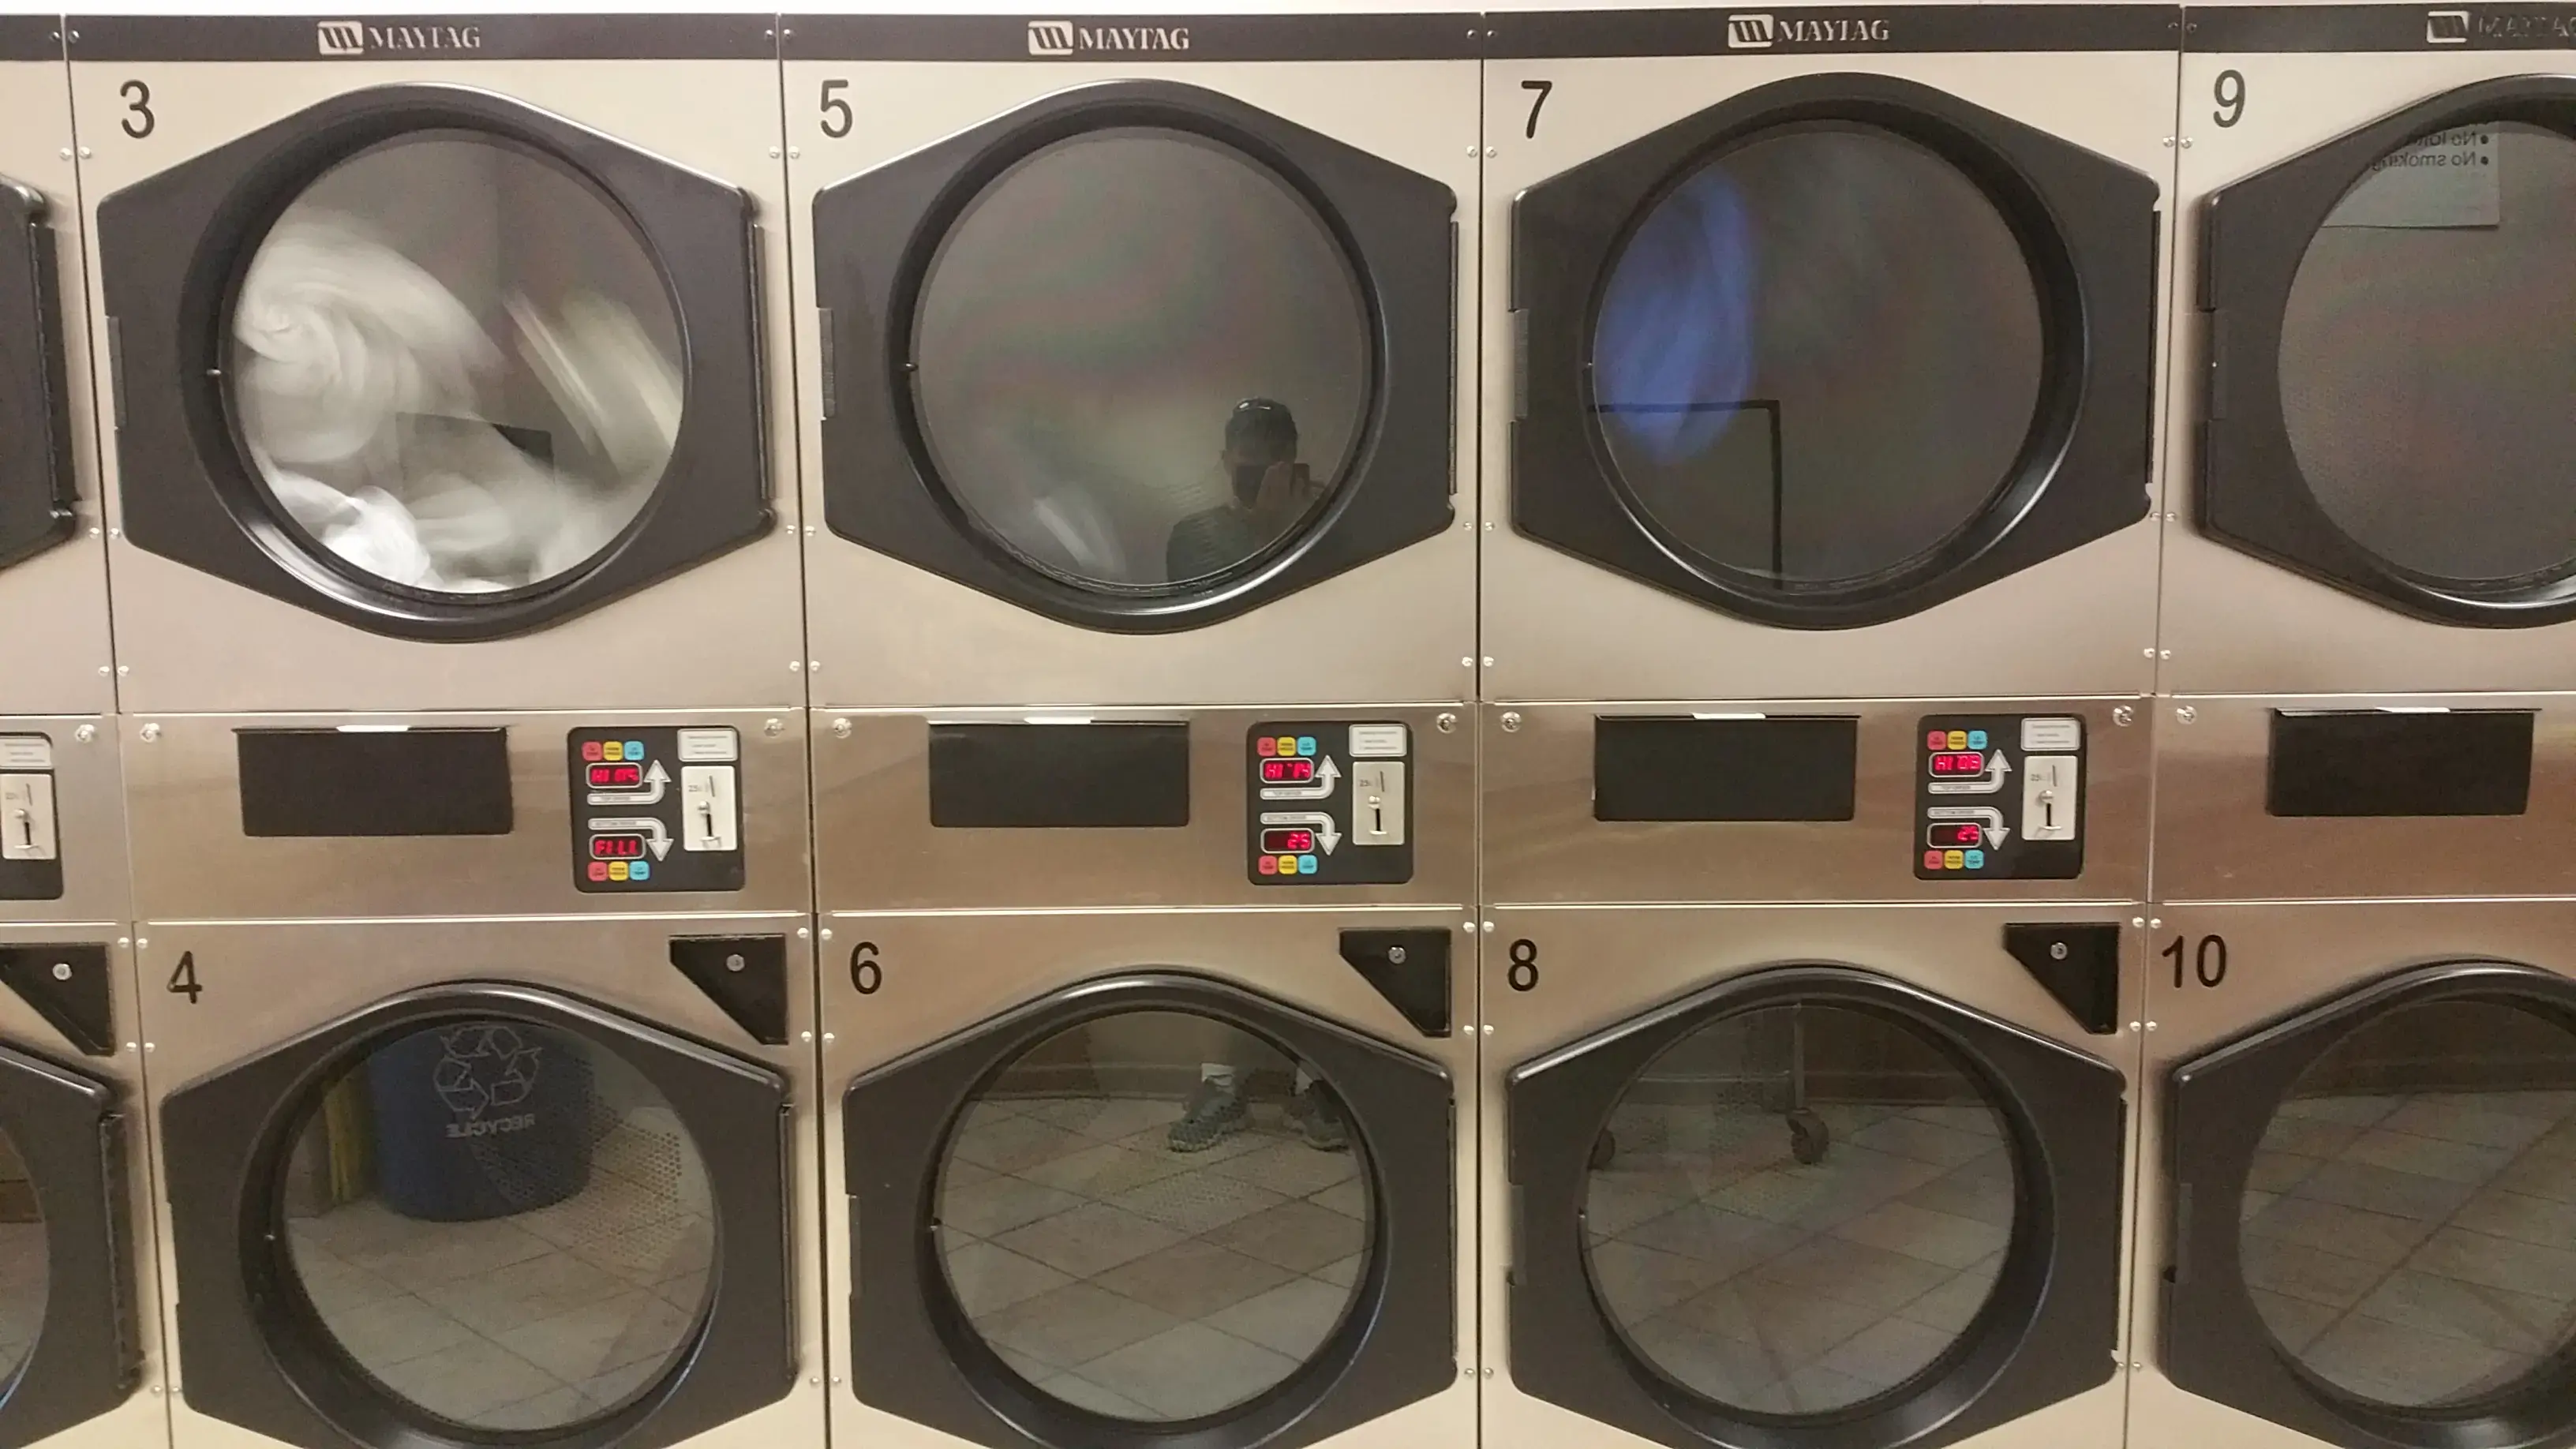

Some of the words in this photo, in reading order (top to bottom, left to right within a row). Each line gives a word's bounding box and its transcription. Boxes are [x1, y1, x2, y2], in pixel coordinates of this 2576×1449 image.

[369, 27, 480, 49] MAYTAG
[1079, 28, 1189, 50] MAYTAG
[1779, 20, 1889, 42] MAYTAG
[120, 80, 155, 140] 3
[820, 80, 853, 139] 5
[1521, 80, 1552, 139] 7
[2214, 69, 2245, 129] 9
[167, 951, 203, 1005] 4
[850, 942, 882, 995] 6
[1508, 939, 1539, 992] 8
[2162, 934, 2227, 989] 10
